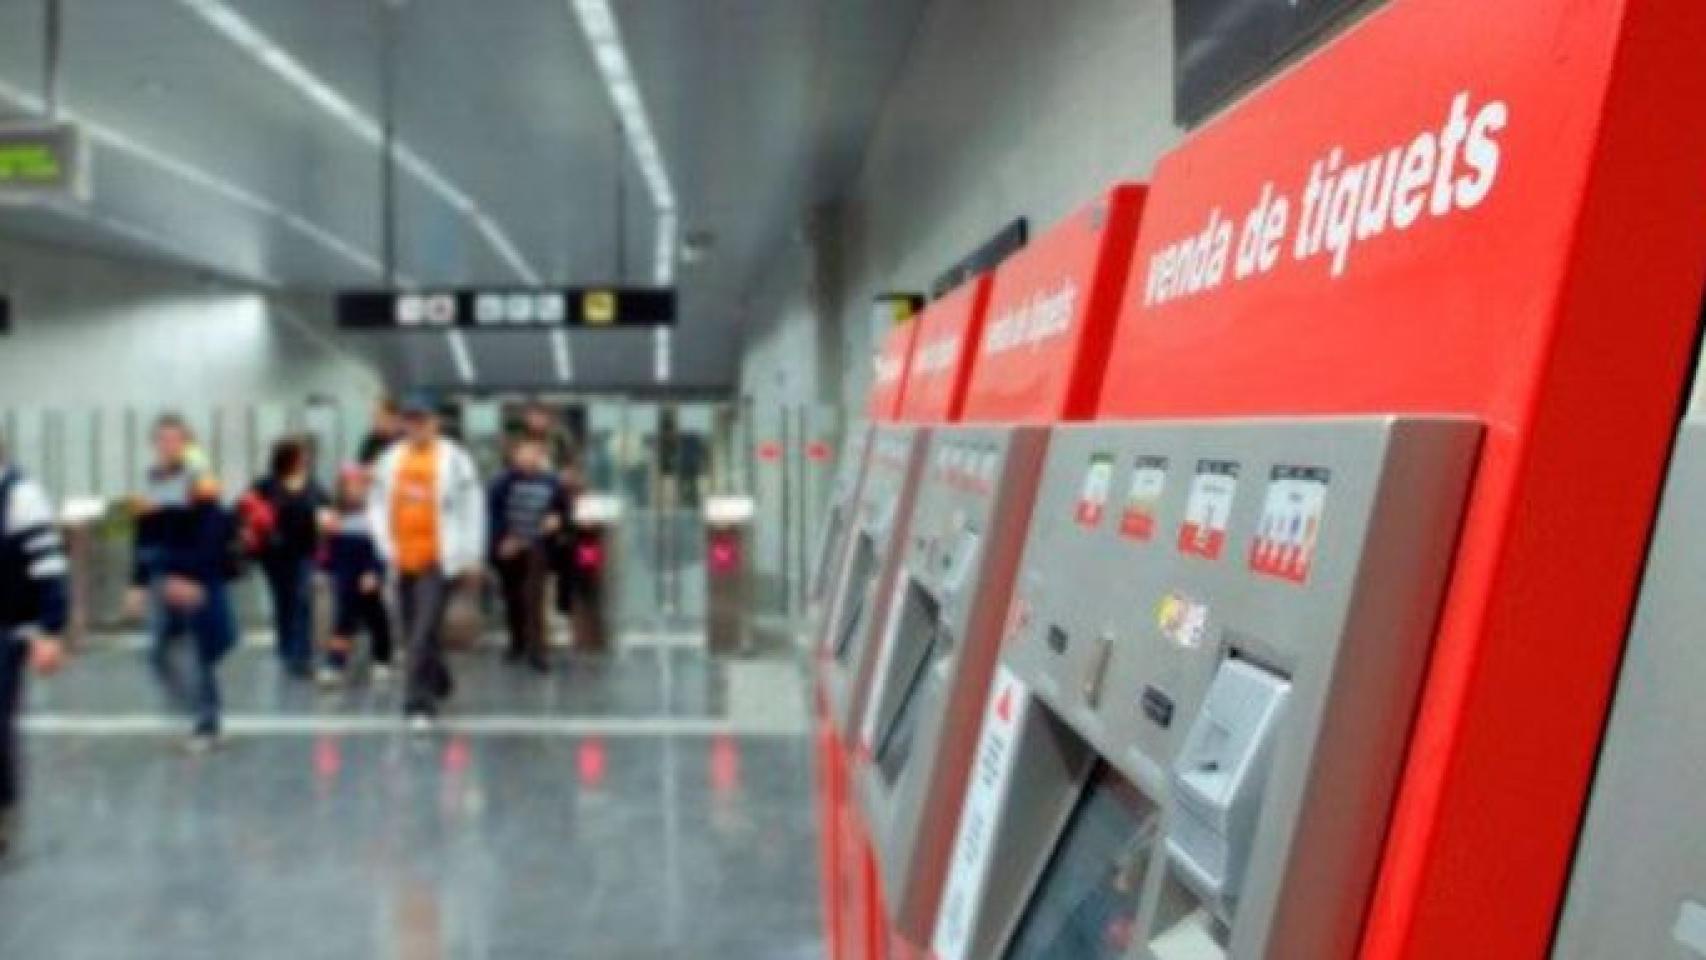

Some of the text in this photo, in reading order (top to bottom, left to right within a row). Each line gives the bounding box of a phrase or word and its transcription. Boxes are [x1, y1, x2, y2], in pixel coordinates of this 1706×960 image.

[1144, 91, 1508, 306] venda de tiquets
